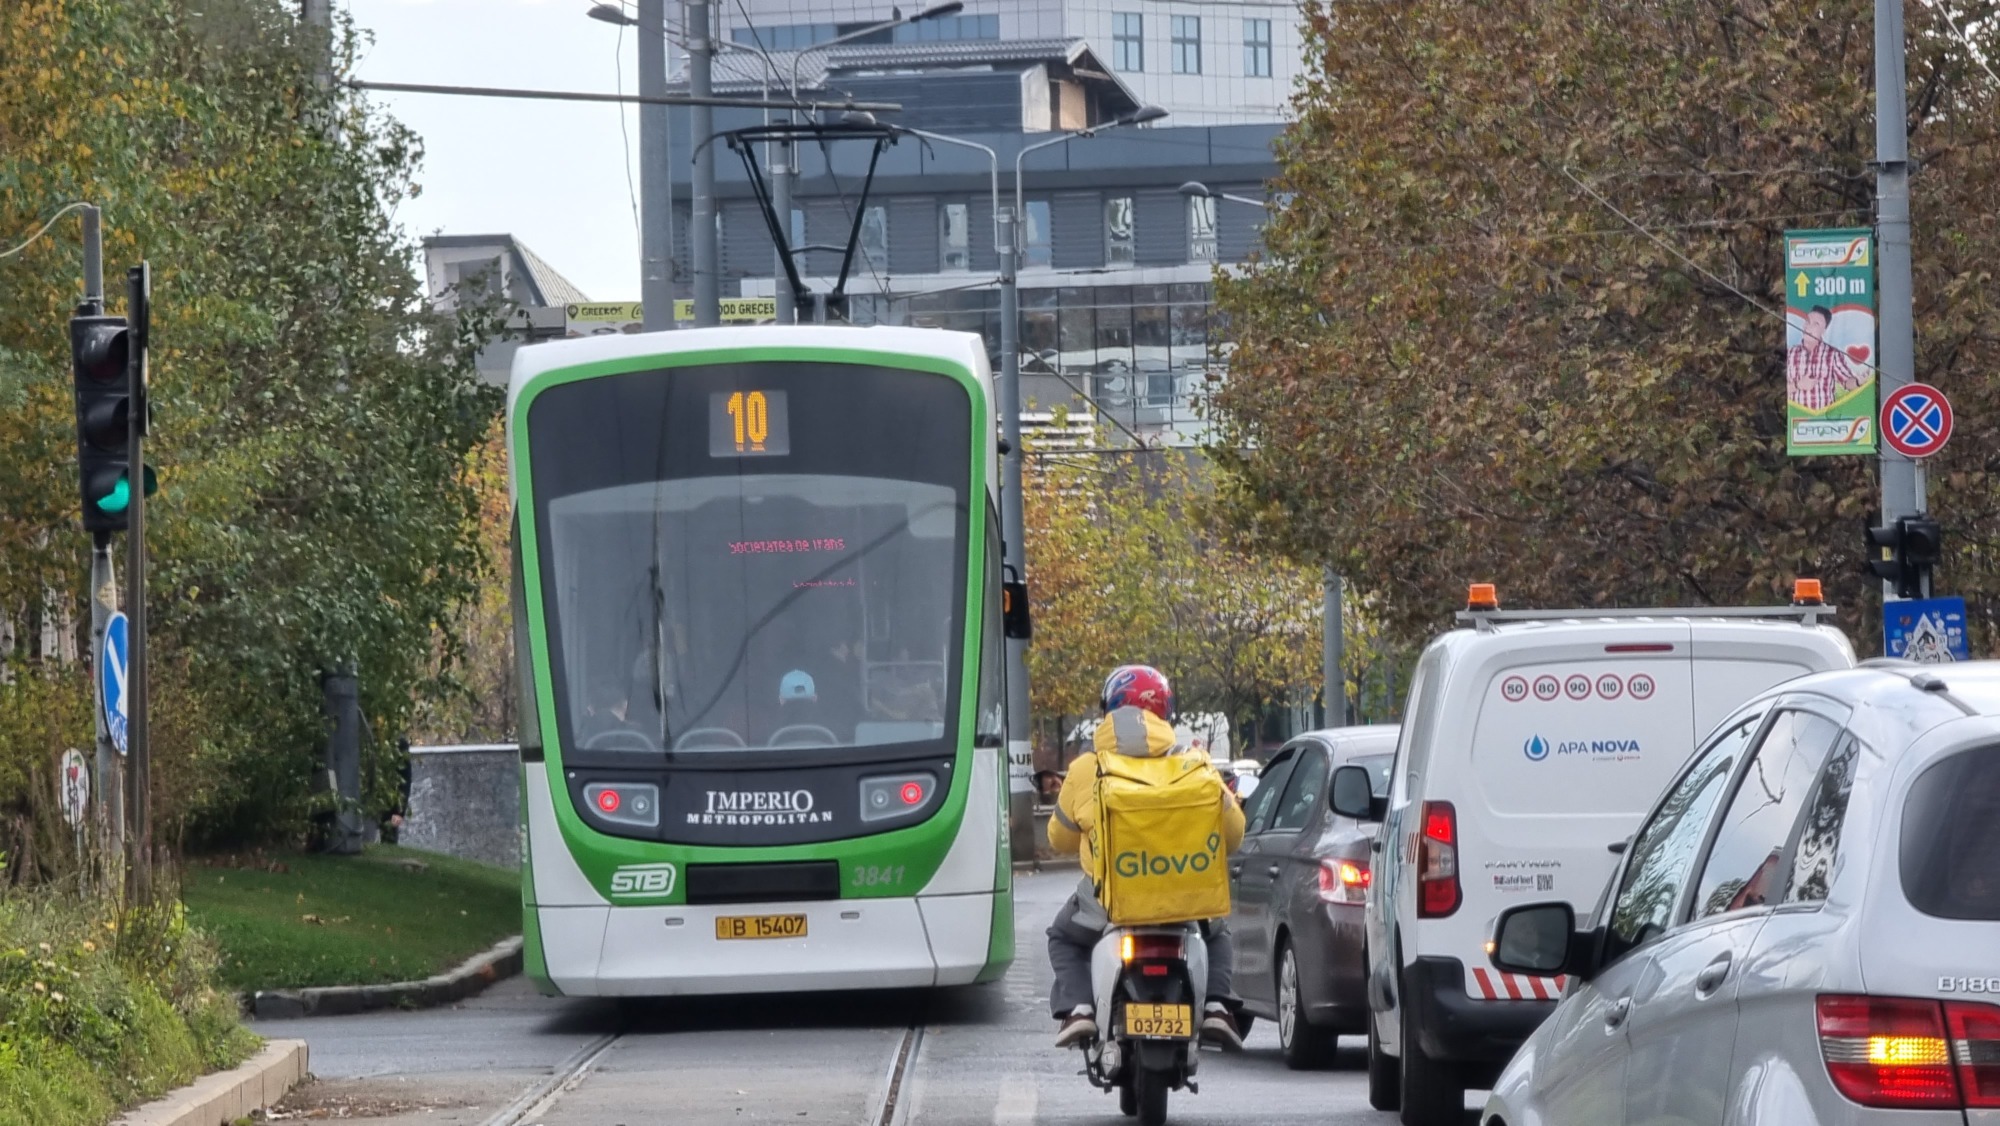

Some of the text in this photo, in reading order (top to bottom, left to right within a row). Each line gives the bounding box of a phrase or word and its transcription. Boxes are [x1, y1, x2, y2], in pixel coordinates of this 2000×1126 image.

[1814, 276, 1866, 296] 300 m
[738, 303, 775, 315] GRECES
[727, 391, 768, 444] 10
[1507, 682, 1649, 695] 50 80 90 110 130
[1557, 740, 1641, 755] APA NOVA
[705, 789, 814, 814] IMPERIO
[686, 811, 832, 825] METROPOLITAN
[1115, 850, 1210, 878] Glovo
[611, 869, 669, 892] STB
[853, 865, 905, 887] 3841
[732, 917, 806, 937] B 15407
[1134, 1019, 1184, 1035] 03732
